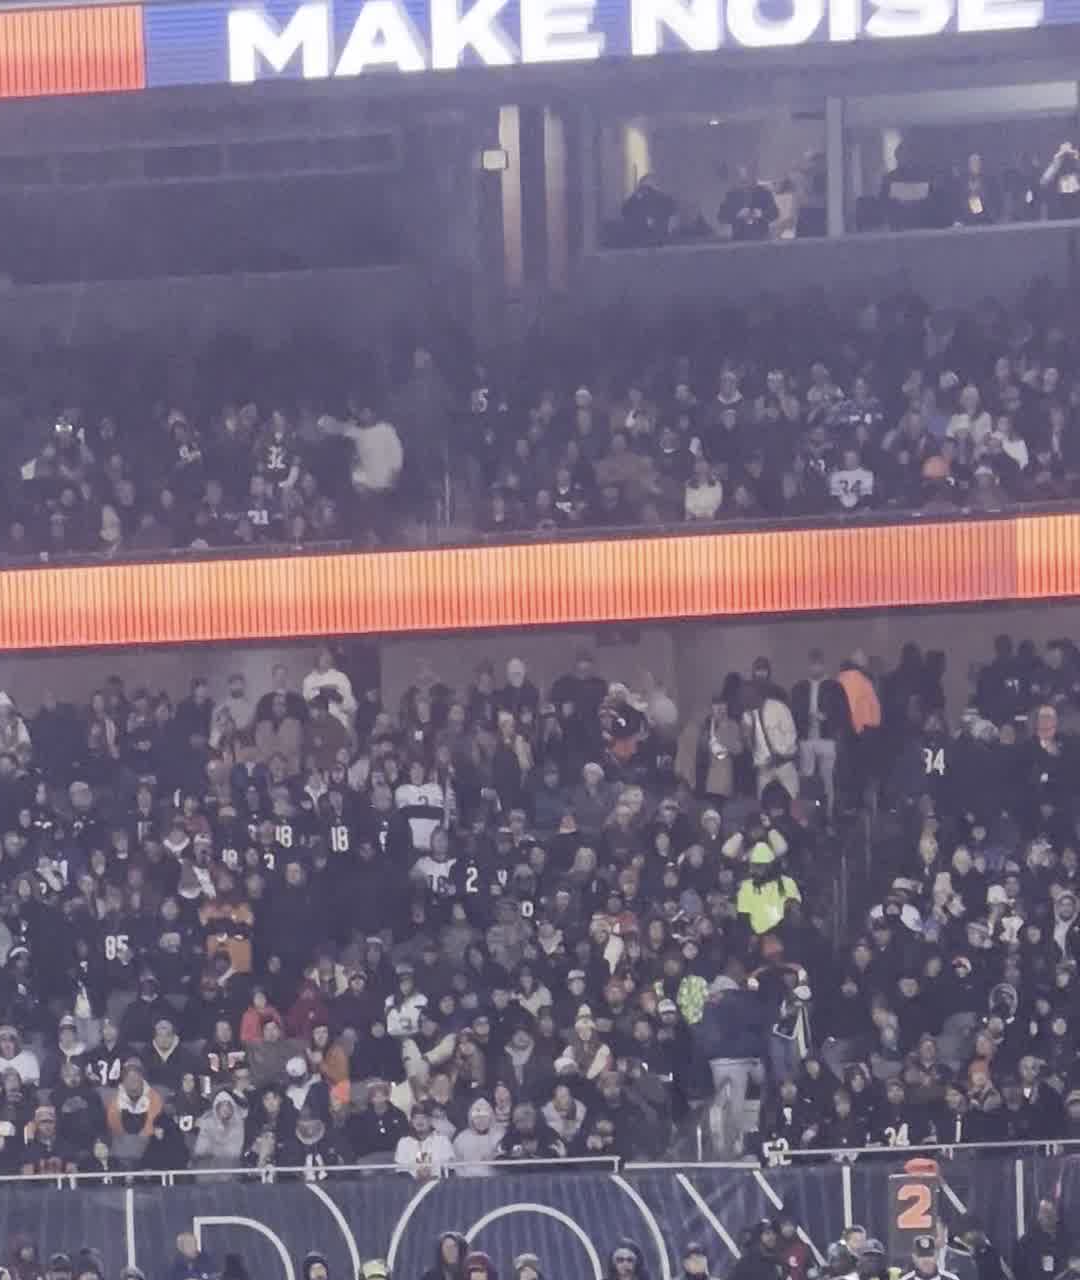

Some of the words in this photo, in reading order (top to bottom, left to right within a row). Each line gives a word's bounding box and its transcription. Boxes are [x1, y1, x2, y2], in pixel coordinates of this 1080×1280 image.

[227, 0, 604, 84] MAKE
[330, 826, 349, 852] 18
[465, 866, 480, 893] 2
[896, 1183, 932, 1229] 2
